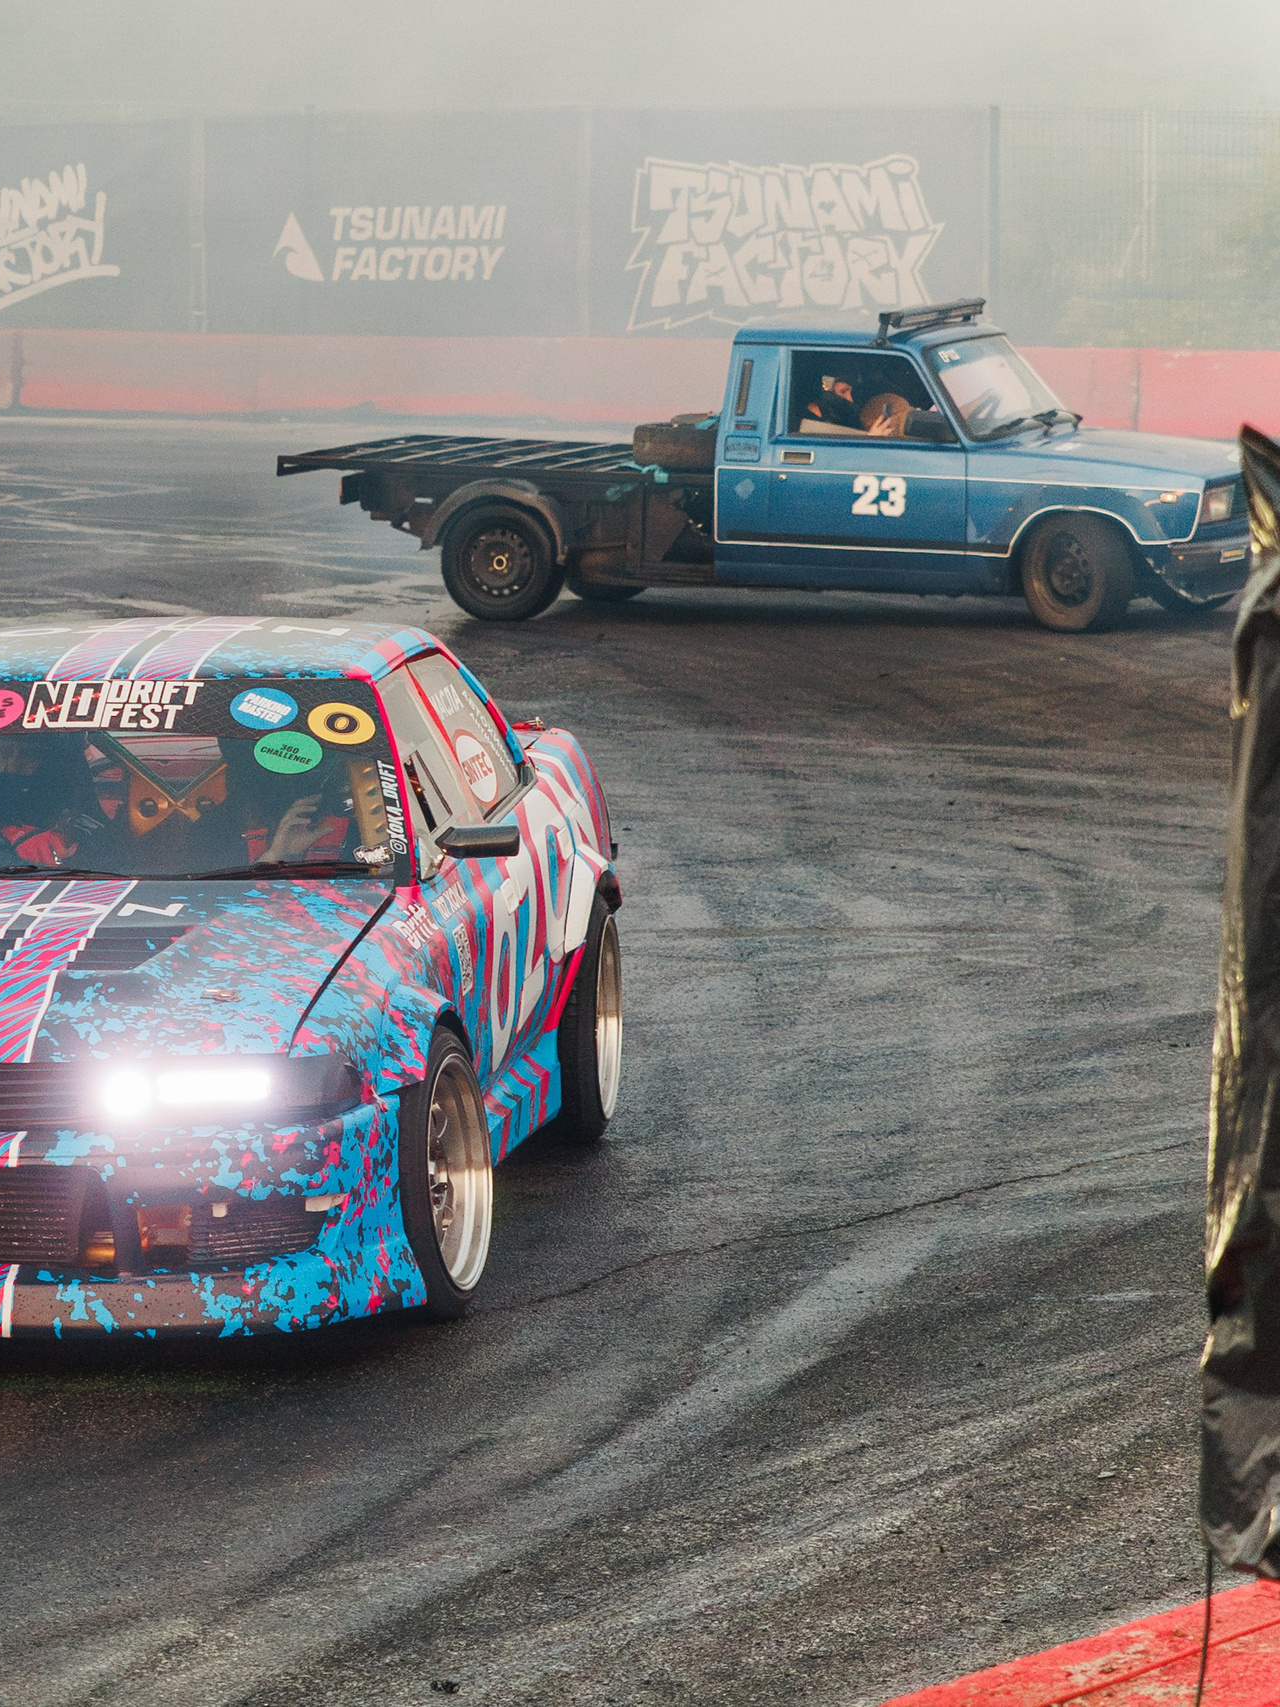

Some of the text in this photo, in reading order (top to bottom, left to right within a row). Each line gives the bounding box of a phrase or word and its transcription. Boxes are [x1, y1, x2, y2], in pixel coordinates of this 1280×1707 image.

[329, 204, 507, 241] TSUNAMI
[330, 246, 506, 282] FACTORY
[650, 230, 932, 308] FACTORY
[852, 474, 907, 517] 23
[106, 680, 205, 705] DRIFT
[243, 692, 292, 717] PARKING
[100, 703, 184, 729] FEST
[237, 702, 283, 724] MASTER
[260, 746, 312, 766] CHALLENGE
[280, 743, 300, 755] 360
[462, 751, 493, 786] SINTEC
[377, 760, 408, 854] @XOKA_DRIFT
